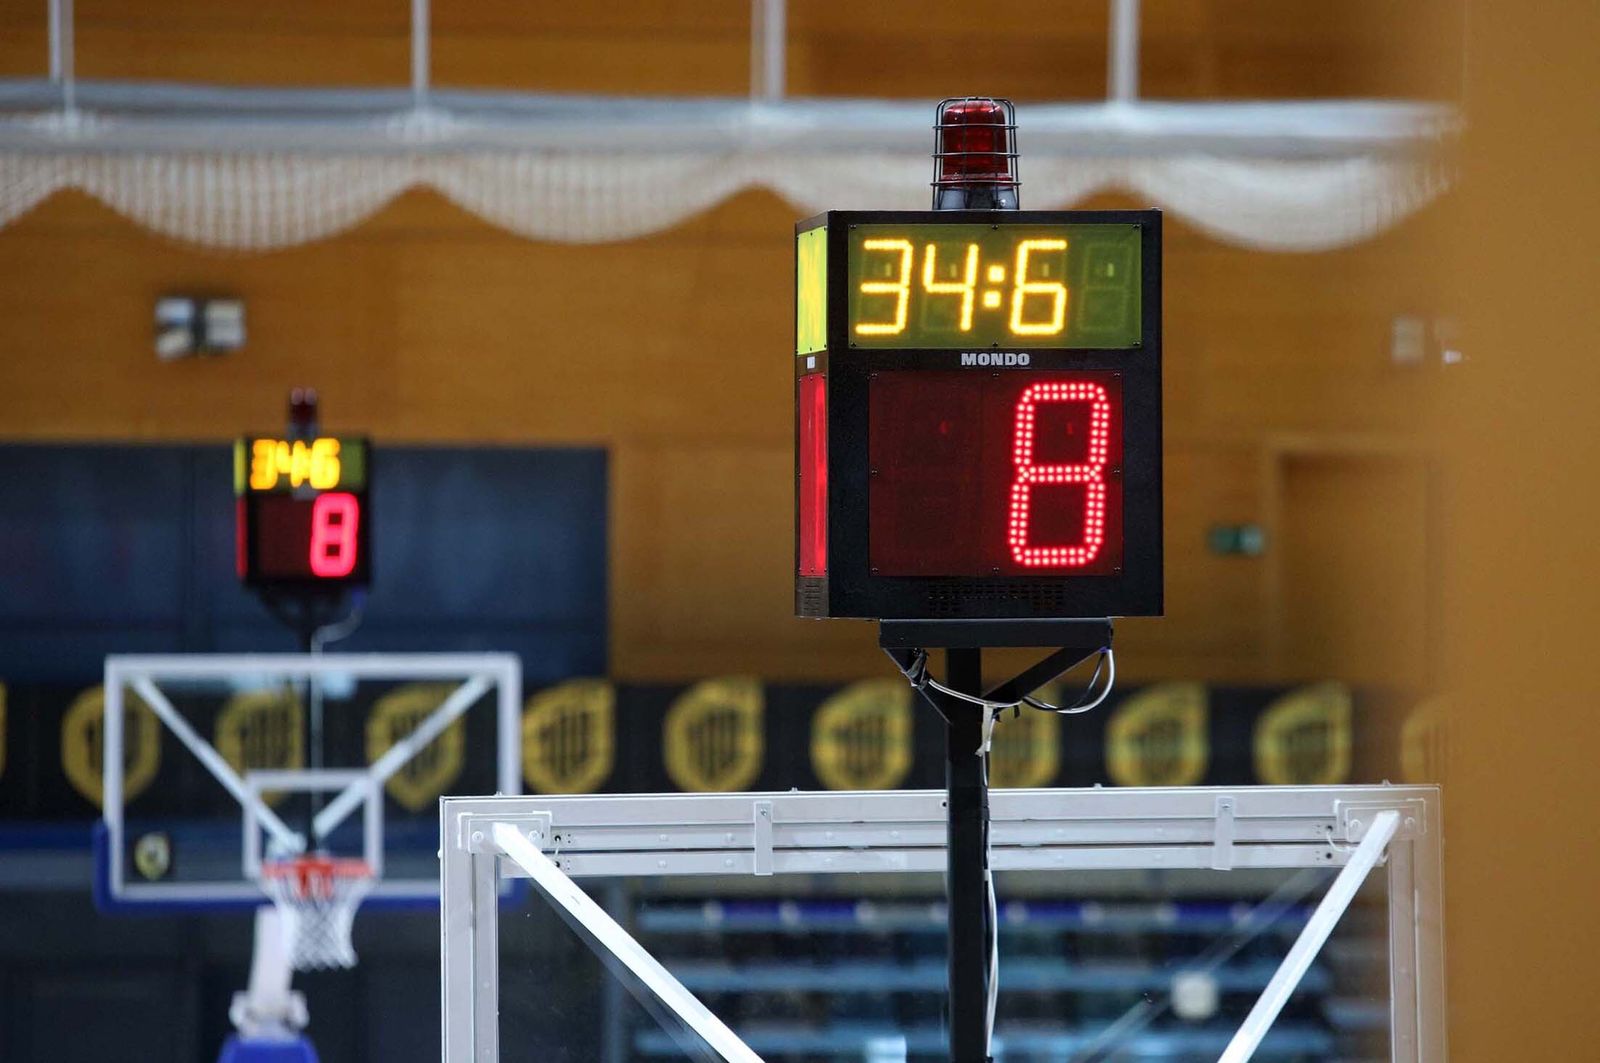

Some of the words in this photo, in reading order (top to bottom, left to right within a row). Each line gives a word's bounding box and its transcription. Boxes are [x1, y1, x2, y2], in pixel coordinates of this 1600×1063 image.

[855, 239, 1068, 335] 34:6
[961, 353, 1030, 366] MONDO
[1009, 382, 1109, 566] 8
[310, 492, 360, 577] 8
